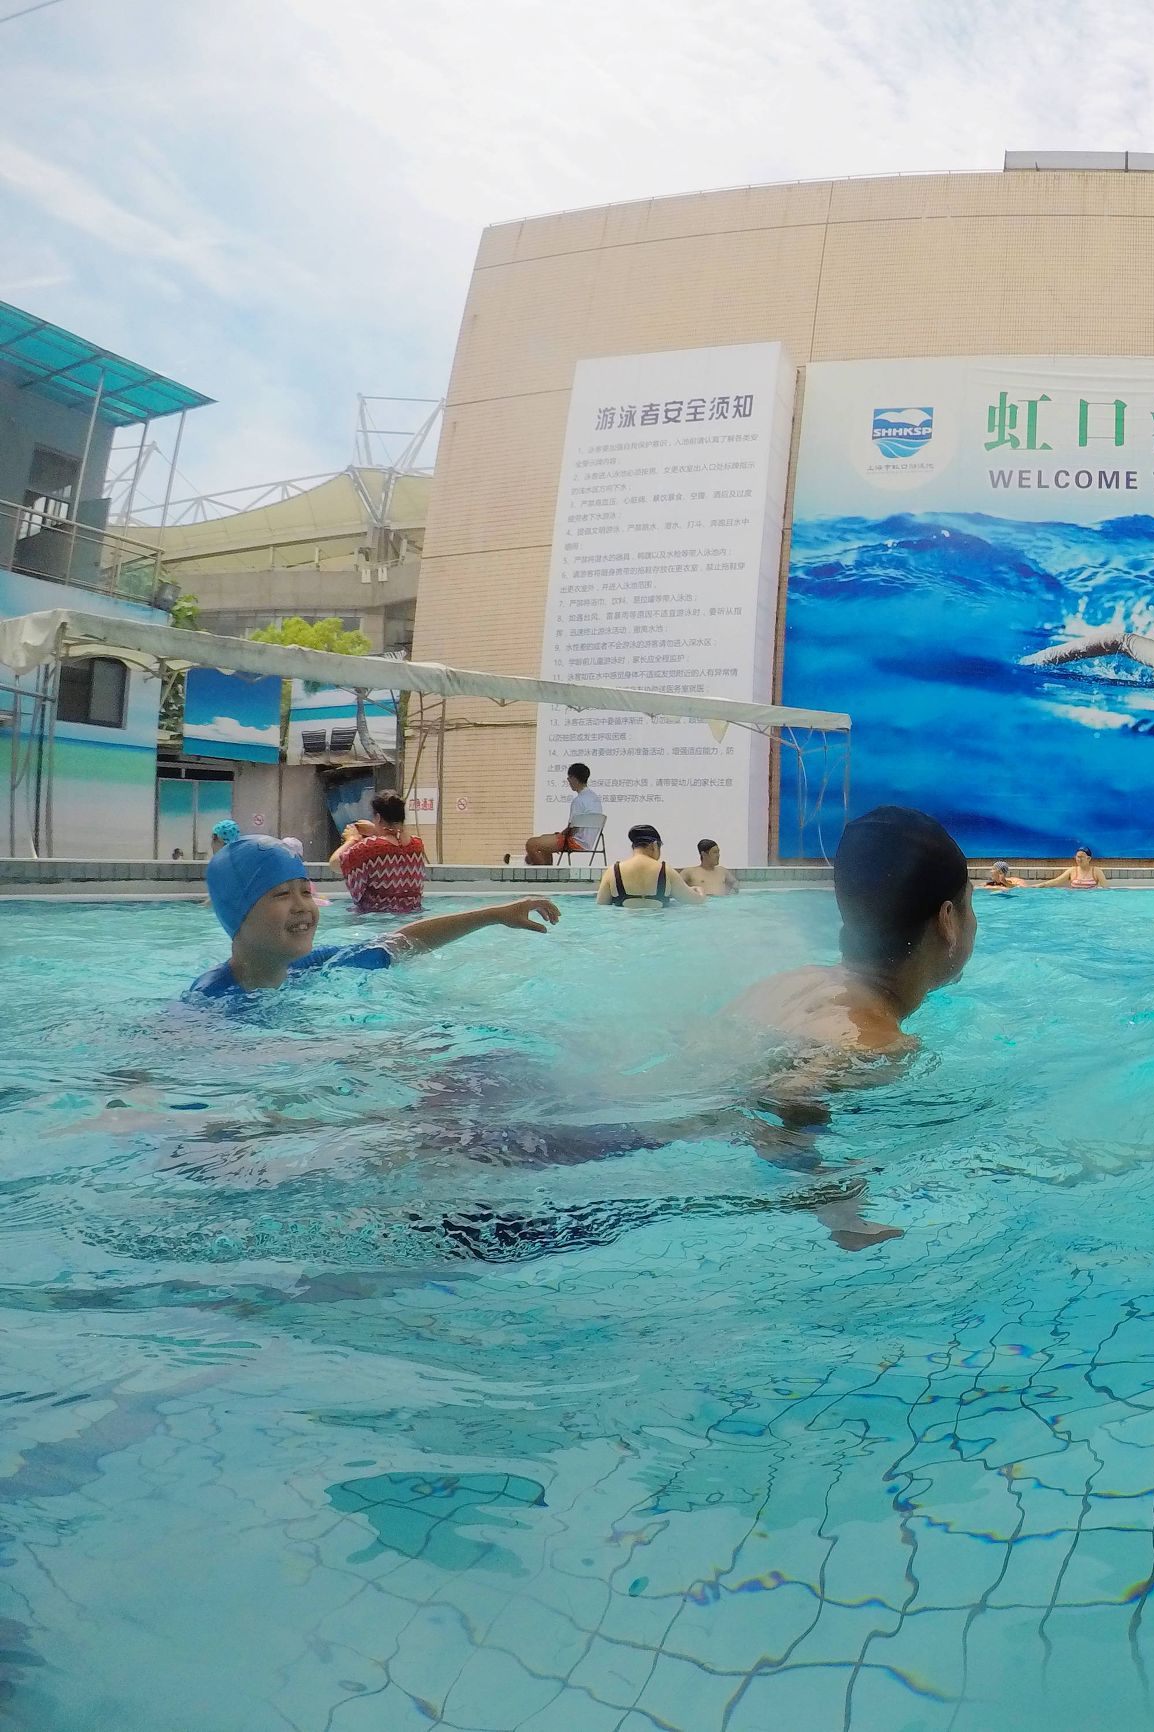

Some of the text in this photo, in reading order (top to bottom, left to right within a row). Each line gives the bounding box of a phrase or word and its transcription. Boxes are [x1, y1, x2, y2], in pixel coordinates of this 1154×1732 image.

[595, 394, 754, 431] 游泳者安全须知
[873, 427, 932, 437] SHHKSP
[989, 469, 1138, 490] WELCOME
